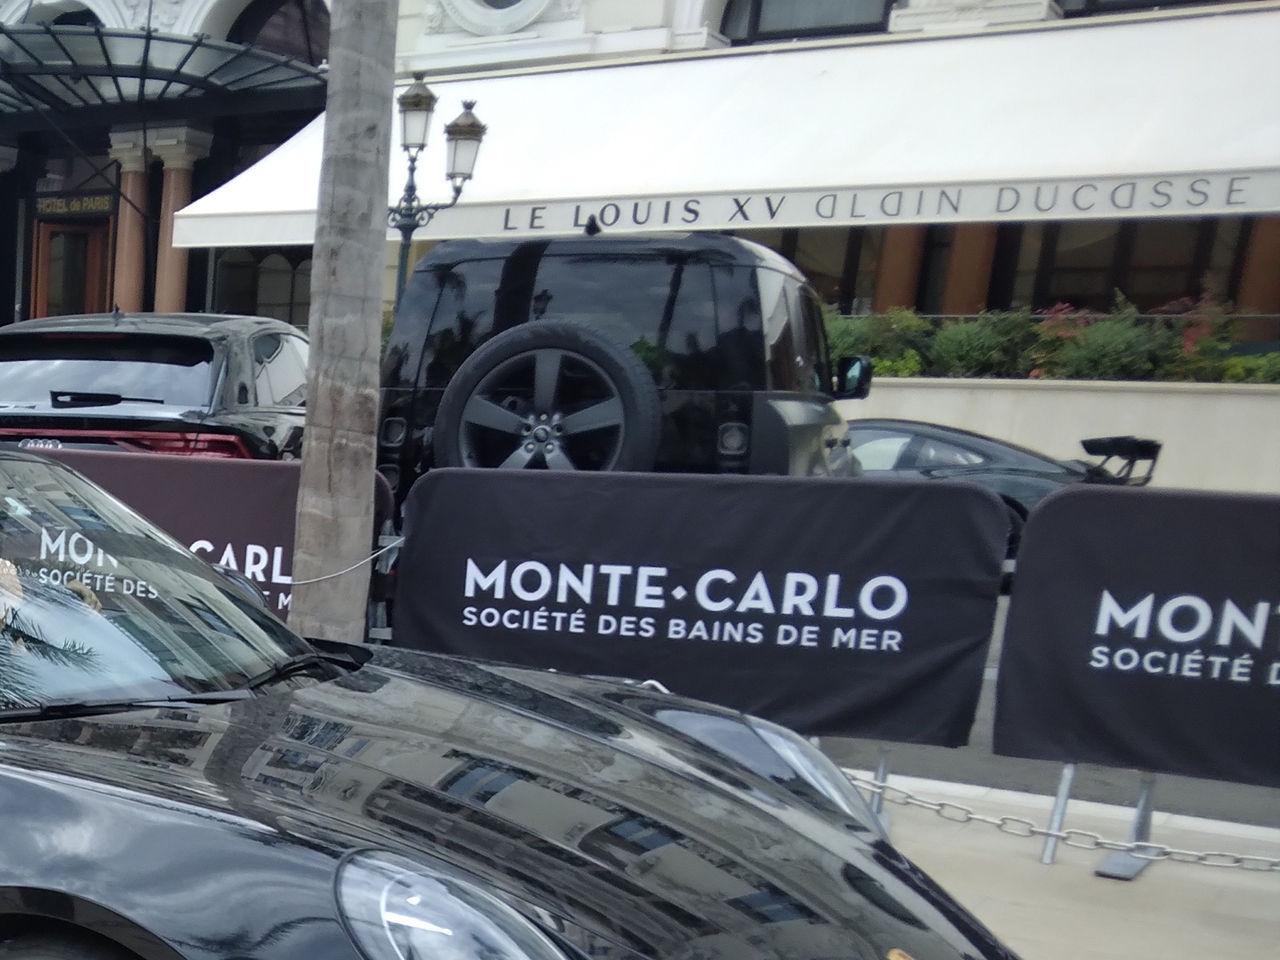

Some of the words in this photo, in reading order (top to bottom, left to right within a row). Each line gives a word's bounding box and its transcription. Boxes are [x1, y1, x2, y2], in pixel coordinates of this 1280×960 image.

[503, 206, 547, 230] LE
[573, 199, 701, 228] LOUIS
[728, 195, 787, 222] XV
[123, 578, 159, 599] DES
[462, 605, 587, 634] SOCIÉTÉ
[597, 614, 657, 638] DES
[667, 618, 765, 645] BAINS
[776, 624, 820, 647] DE
[831, 627, 903, 652] MER
[1093, 588, 1280, 650] MON
[1088, 645, 1255, 683] SOCIÉTÉ
